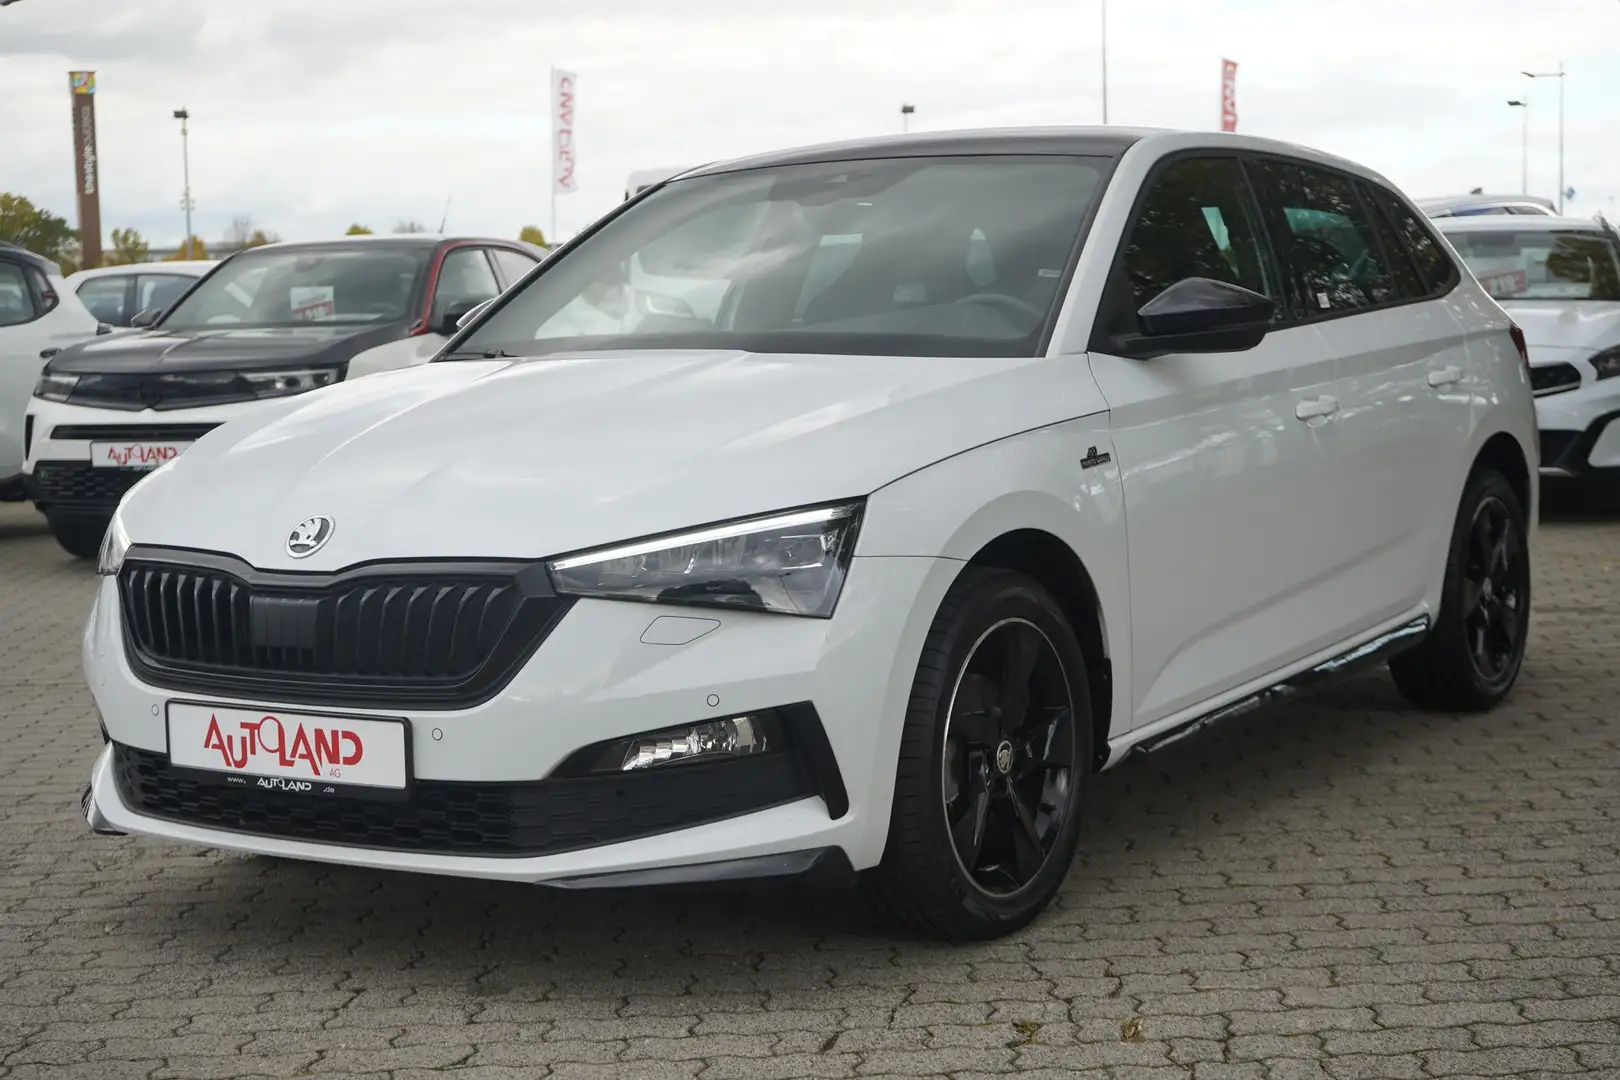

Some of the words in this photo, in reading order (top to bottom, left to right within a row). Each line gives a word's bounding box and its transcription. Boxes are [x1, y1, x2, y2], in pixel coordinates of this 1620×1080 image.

[203, 713, 363, 776] AUTOLAND
[328, 767, 342, 779] AG
[256, 777, 312, 792] AUTOLAND
